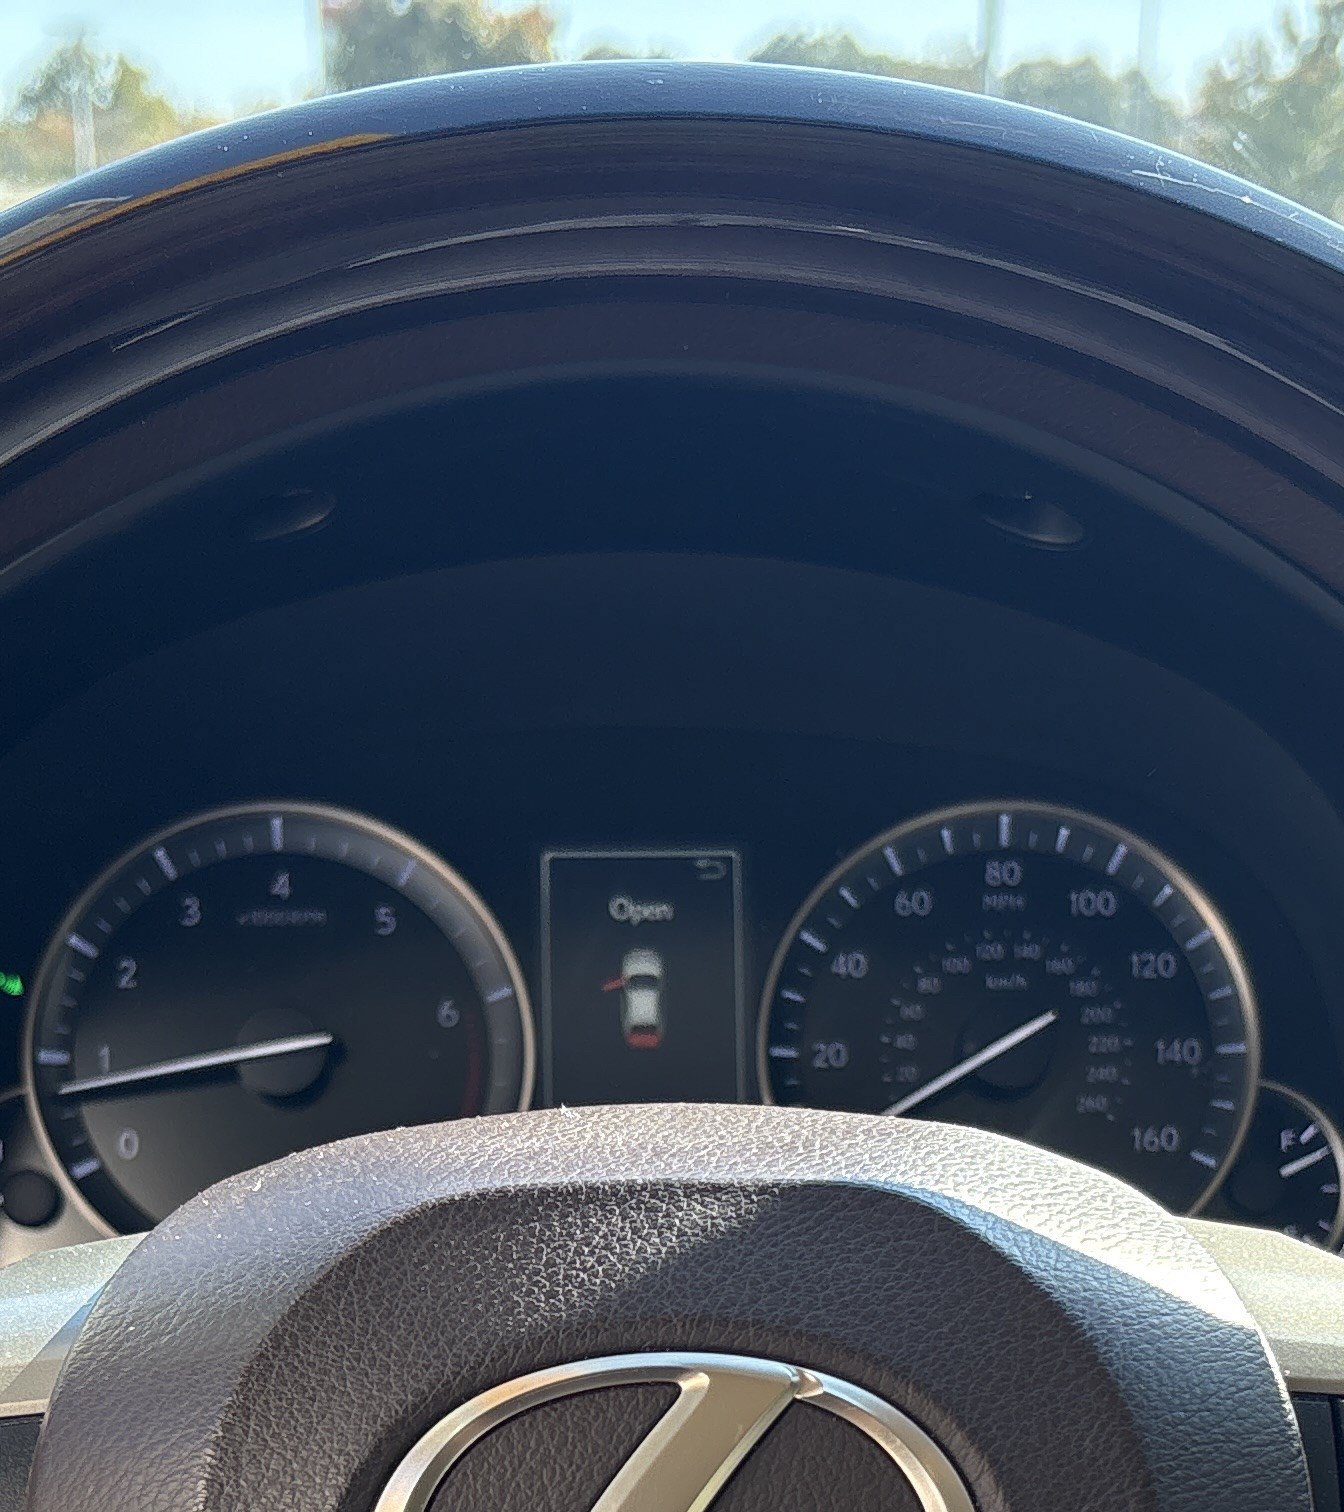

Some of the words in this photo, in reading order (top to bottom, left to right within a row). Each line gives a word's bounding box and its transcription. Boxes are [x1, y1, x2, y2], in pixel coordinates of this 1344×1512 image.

[270, 871, 292, 900] 4
[985, 860, 1023, 887] 80
[179, 896, 201, 926] 3
[608, 895, 674, 926] Open
[894, 889, 934, 917] 60
[1069, 888, 1119, 917] 100
[374, 905, 397, 936] 5
[117, 959, 139, 990] 2
[831, 951, 869, 979] 40
[1131, 952, 1177, 979] 120
[436, 1000, 460, 1028] 6
[97, 1044, 111, 1071] 1
[813, 1042, 849, 1069] 20
[1156, 1037, 1202, 1065] 140
[117, 1129, 141, 1160] 0
[1133, 1125, 1179, 1152] 160
